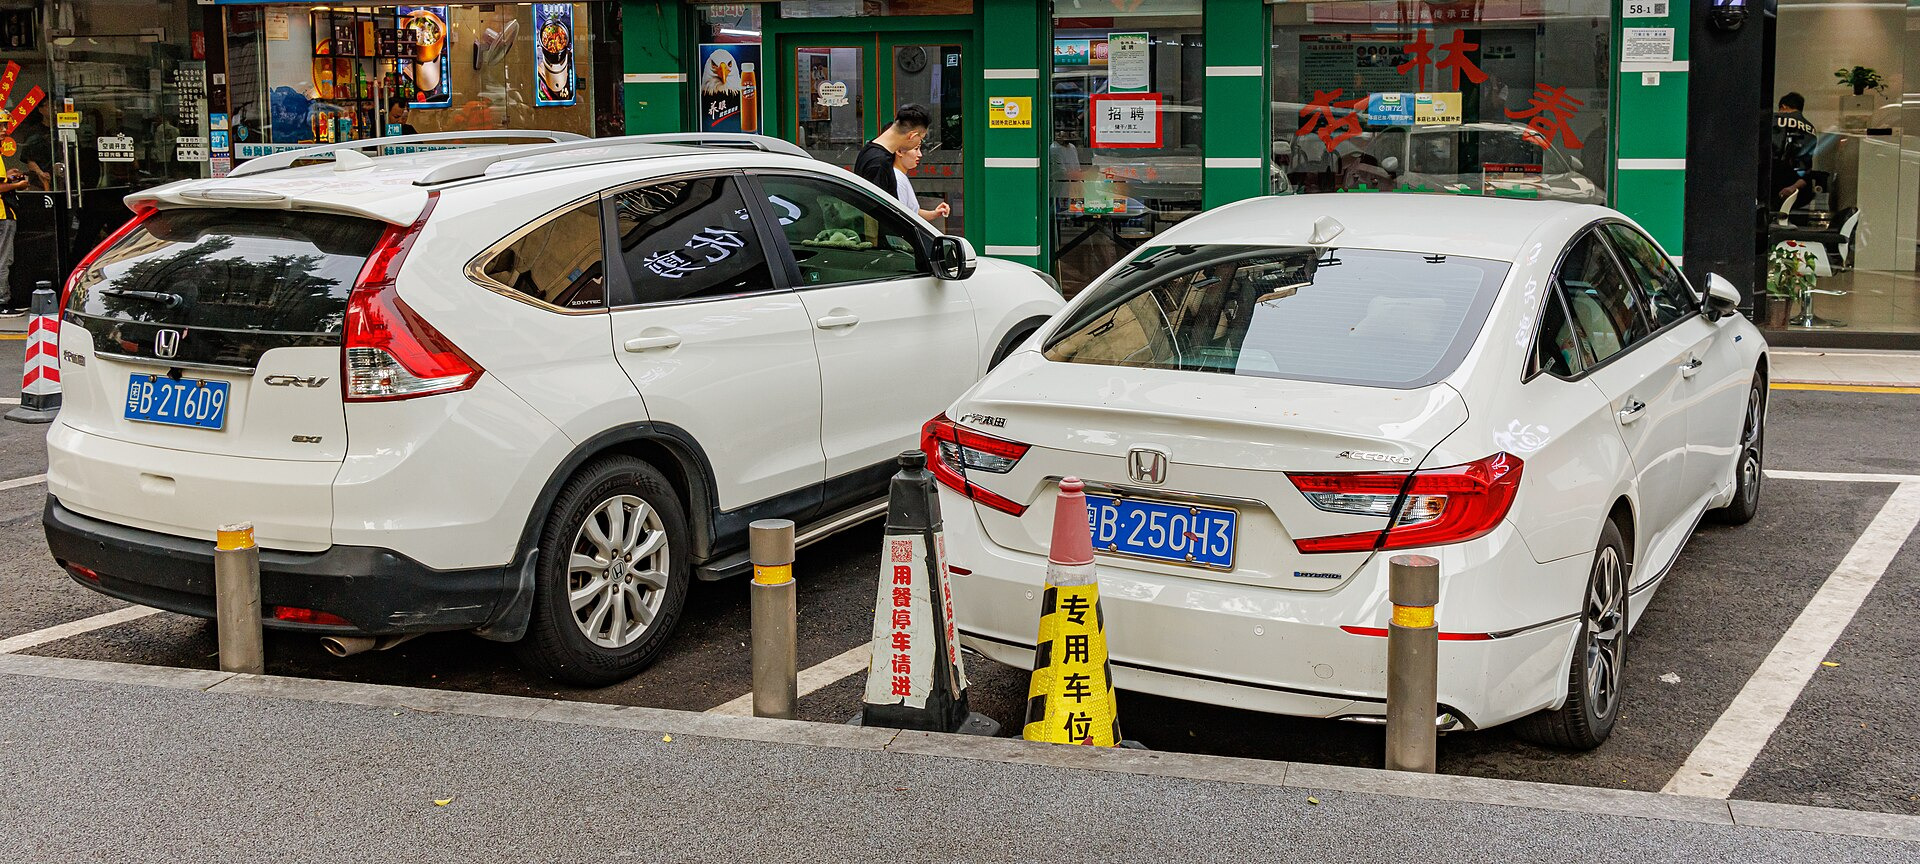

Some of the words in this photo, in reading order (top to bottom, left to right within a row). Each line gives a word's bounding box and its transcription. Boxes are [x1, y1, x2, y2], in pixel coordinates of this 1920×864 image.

[1630, 5, 1651, 14] 58-1
[1108, 106, 1145, 121] 招聘
[1336, 450, 1412, 465] ACCORD
[892, 565, 912, 697] 用餐停车请进
[1060, 594, 1094, 742] 专用车位
